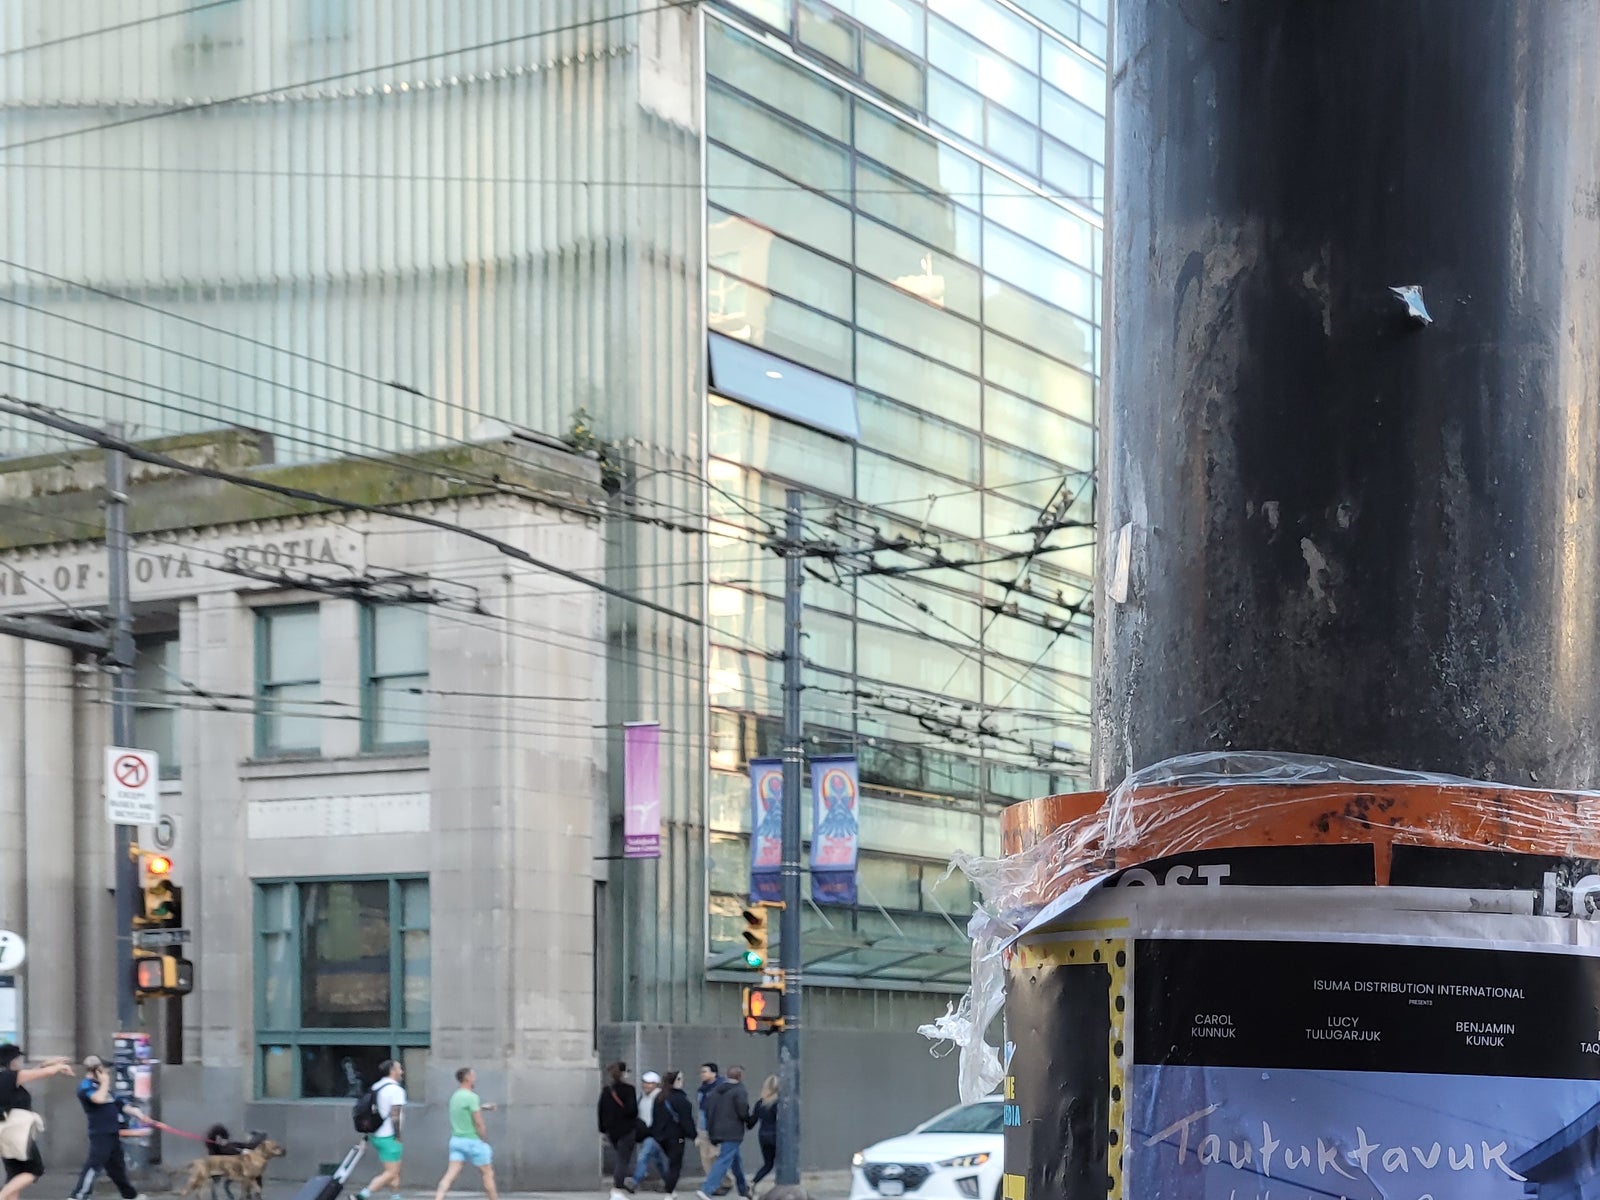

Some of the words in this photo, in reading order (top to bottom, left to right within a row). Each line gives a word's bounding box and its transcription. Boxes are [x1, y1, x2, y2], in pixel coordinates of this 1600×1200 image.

[54, 564, 91, 592] OF
[135, 553, 194, 583] OVA
[224, 537, 338, 569] SCOTIA
[1314, 980, 1351, 991] ISUMA
[1354, 981, 1434, 995] DISTRIBUTION
[1437, 985, 1525, 999] INTERNATIONAL
[1194, 1014, 1234, 1025] CAROL
[1328, 1017, 1359, 1027] LUCY
[1191, 1027, 1236, 1038] KUNNUK
[1305, 1028, 1381, 1042] TULUGARJUK
[1455, 1022, 1515, 1035] BENJAMIN
[1466, 1036, 1504, 1047] KUNUK
[1142, 1101, 1529, 1182] Tautuktavuk
